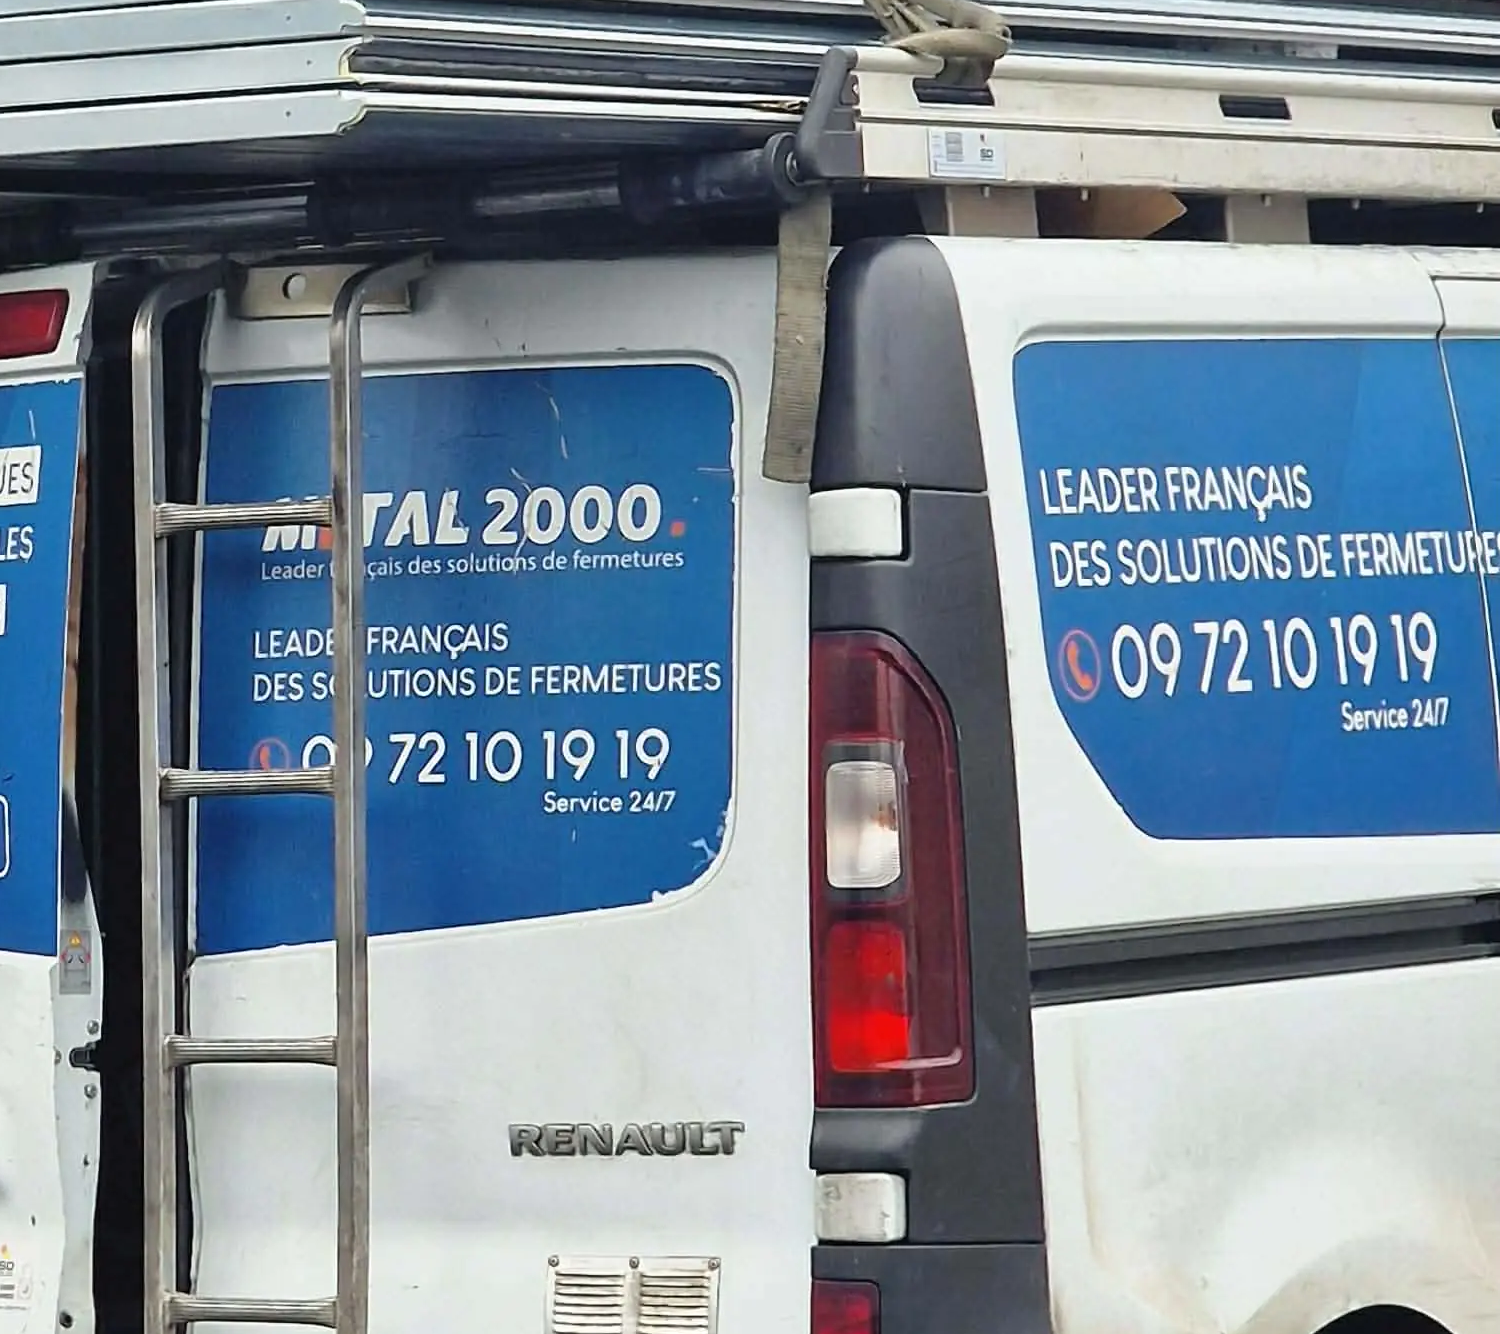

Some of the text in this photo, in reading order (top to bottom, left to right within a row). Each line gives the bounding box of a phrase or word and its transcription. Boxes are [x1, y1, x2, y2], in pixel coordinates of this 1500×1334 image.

[1039, 464, 1313, 523] LEADER FRANÇAIS
[261, 558, 326, 582] Leader
[407, 553, 442, 576] des
[446, 549, 538, 576] solutions
[541, 548, 569, 572] de
[572, 548, 685, 571] fermetures
[1049, 530, 1500, 589] DES SOLUTIONS DE FERMETURE
[254, 621, 510, 660] LEADE FRANÇAIS
[1110, 610, 1438, 700] 09 72 10 19 19
[253, 662, 722, 703] DES SUTIONS DE FERMETURES
[1341, 695, 1450, 732] Service 24/7
[388, 731, 447, 785] 72
[465, 729, 523, 783] 10
[542, 728, 596, 782] 19
[615, 727, 671, 781] 19
[543, 789, 677, 814] Service 24/7
[507, 1120, 746, 1158] RENAULT
